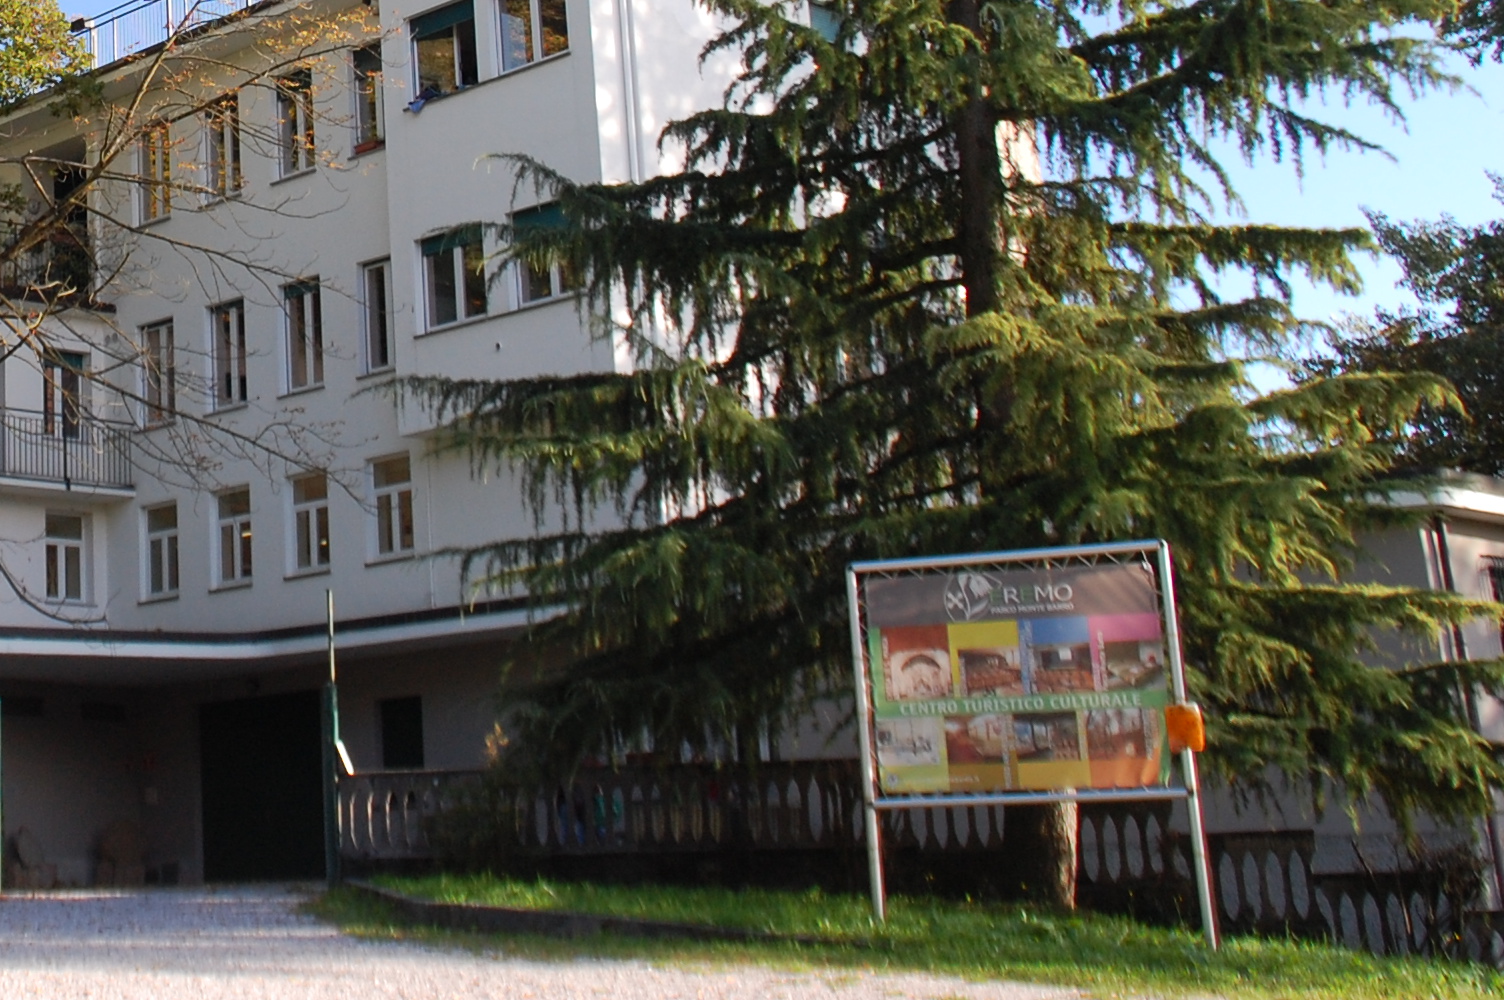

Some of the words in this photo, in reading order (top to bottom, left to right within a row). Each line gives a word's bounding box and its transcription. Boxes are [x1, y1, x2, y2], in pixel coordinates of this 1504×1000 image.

[899, 700, 958, 716] CENTRO
[963, 698, 1045, 714] TURISTICO
[1050, 693, 1142, 710] CULTURALE
